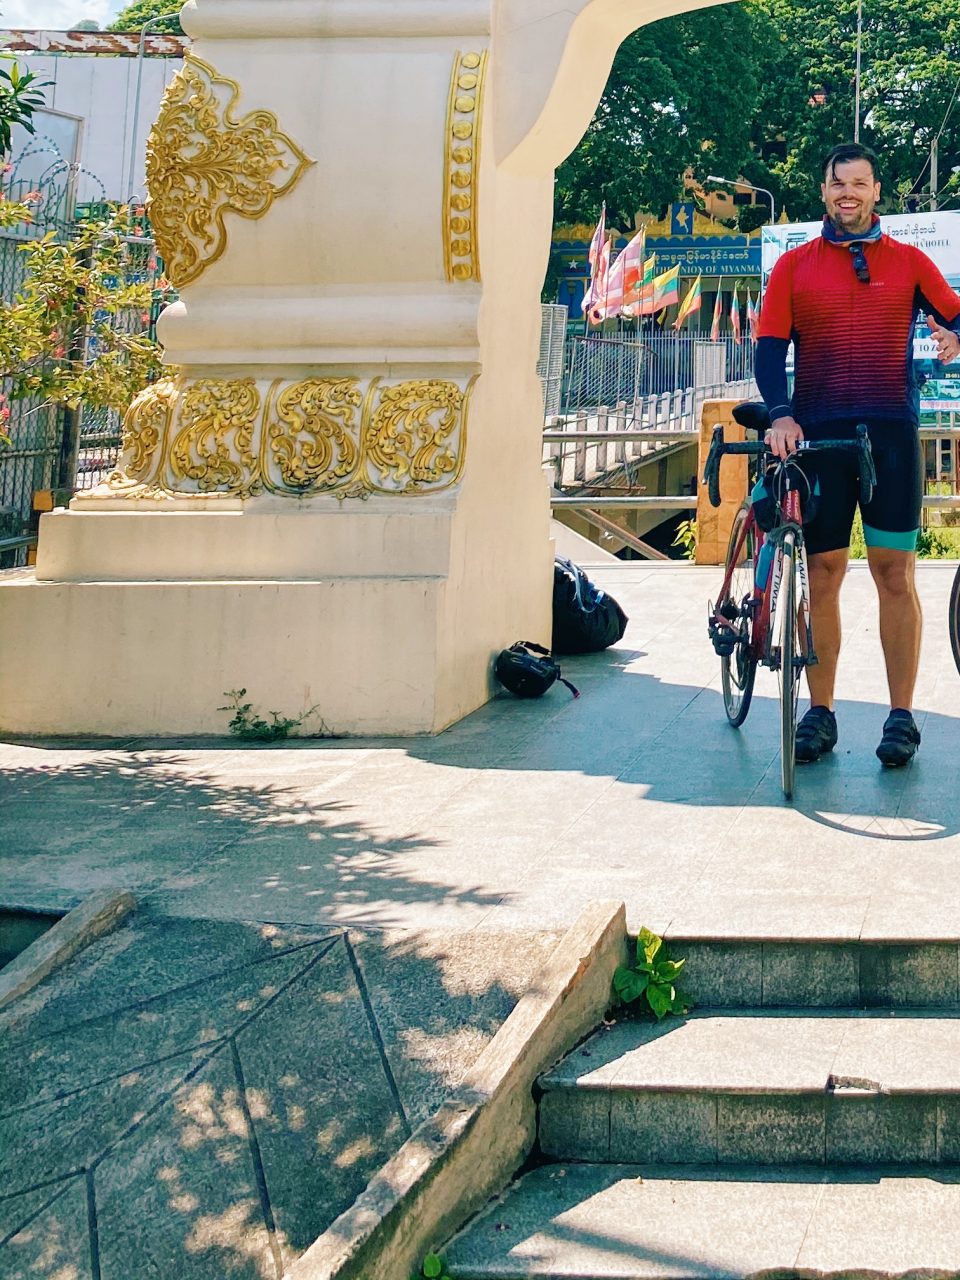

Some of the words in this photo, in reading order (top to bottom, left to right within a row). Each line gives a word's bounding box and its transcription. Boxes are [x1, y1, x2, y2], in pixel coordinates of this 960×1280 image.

[925, 239, 950, 248] HOTEL
[705, 264, 717, 274] OF
[721, 264, 761, 274] MYANMA
